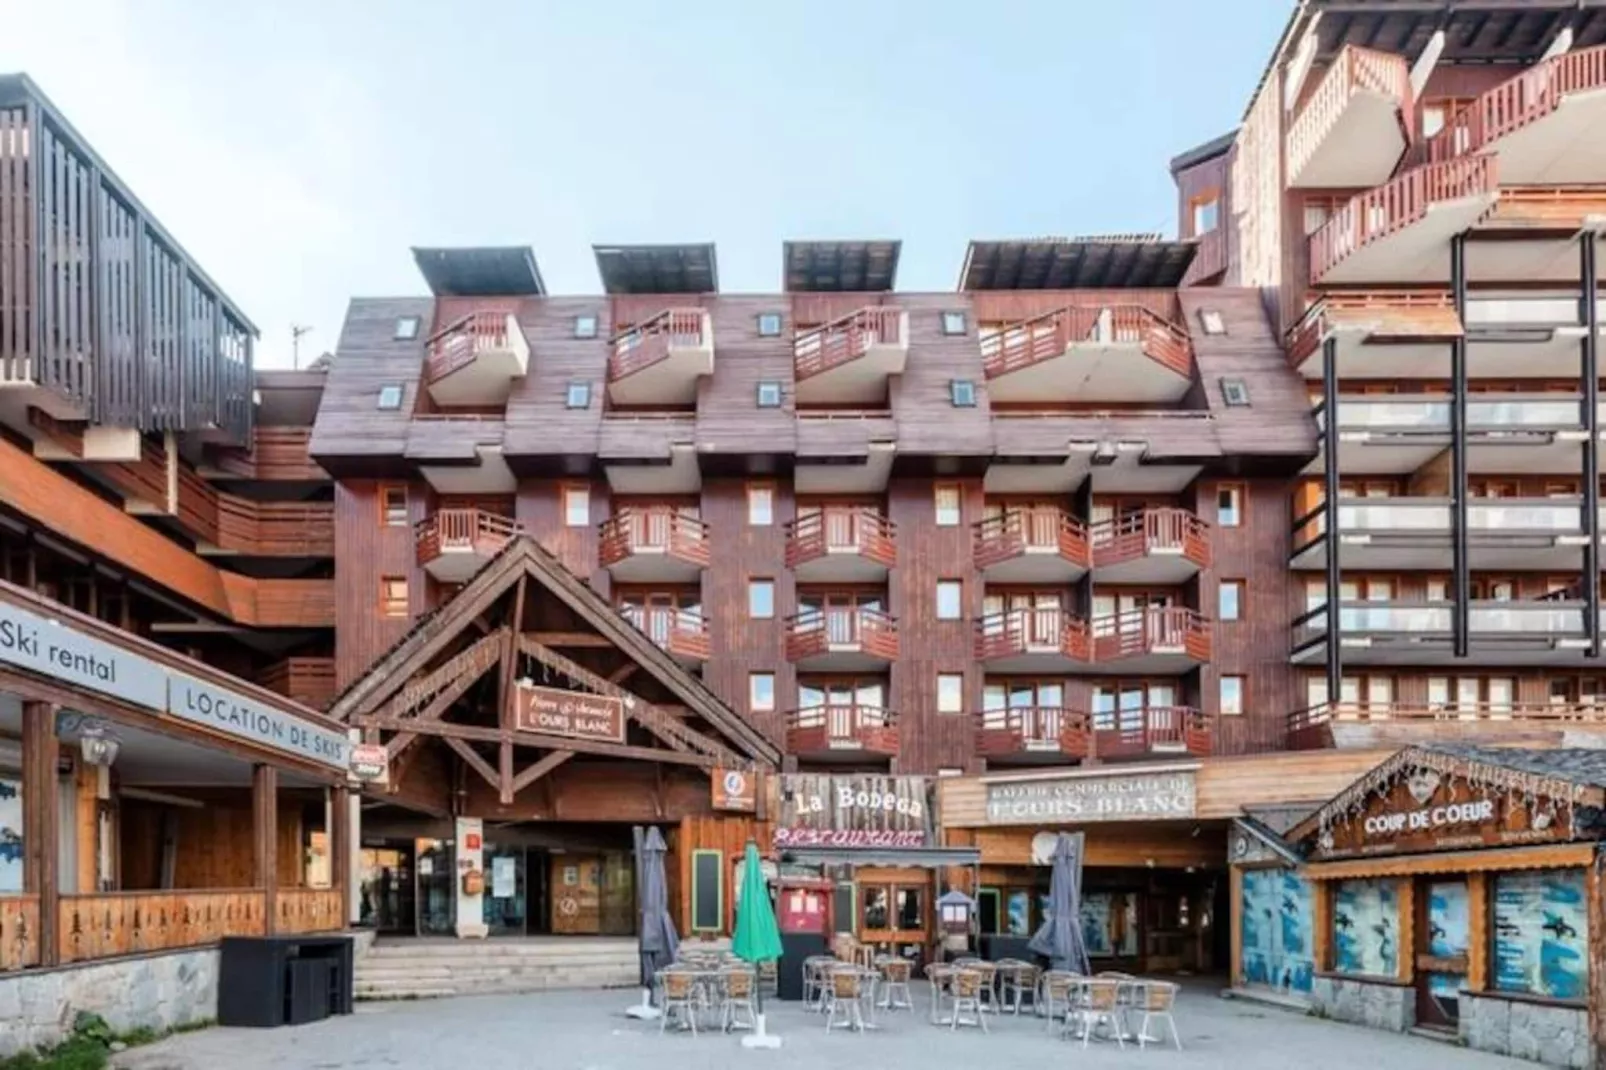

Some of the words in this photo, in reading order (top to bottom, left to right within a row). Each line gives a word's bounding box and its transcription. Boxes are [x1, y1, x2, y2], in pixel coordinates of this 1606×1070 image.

[0, 619, 38, 657] Ski
[49, 645, 116, 683] rental
[186, 688, 284, 738] LOCATION
[290, 725, 308, 749] DE
[314, 734, 342, 760] SKIS
[796, 793, 823, 815] La
[1097, 796, 1190, 813] BLANC
[1364, 813, 1406, 834] COUP
[1409, 809, 1429, 829] DE
[1432, 800, 1493, 824] COEUR
